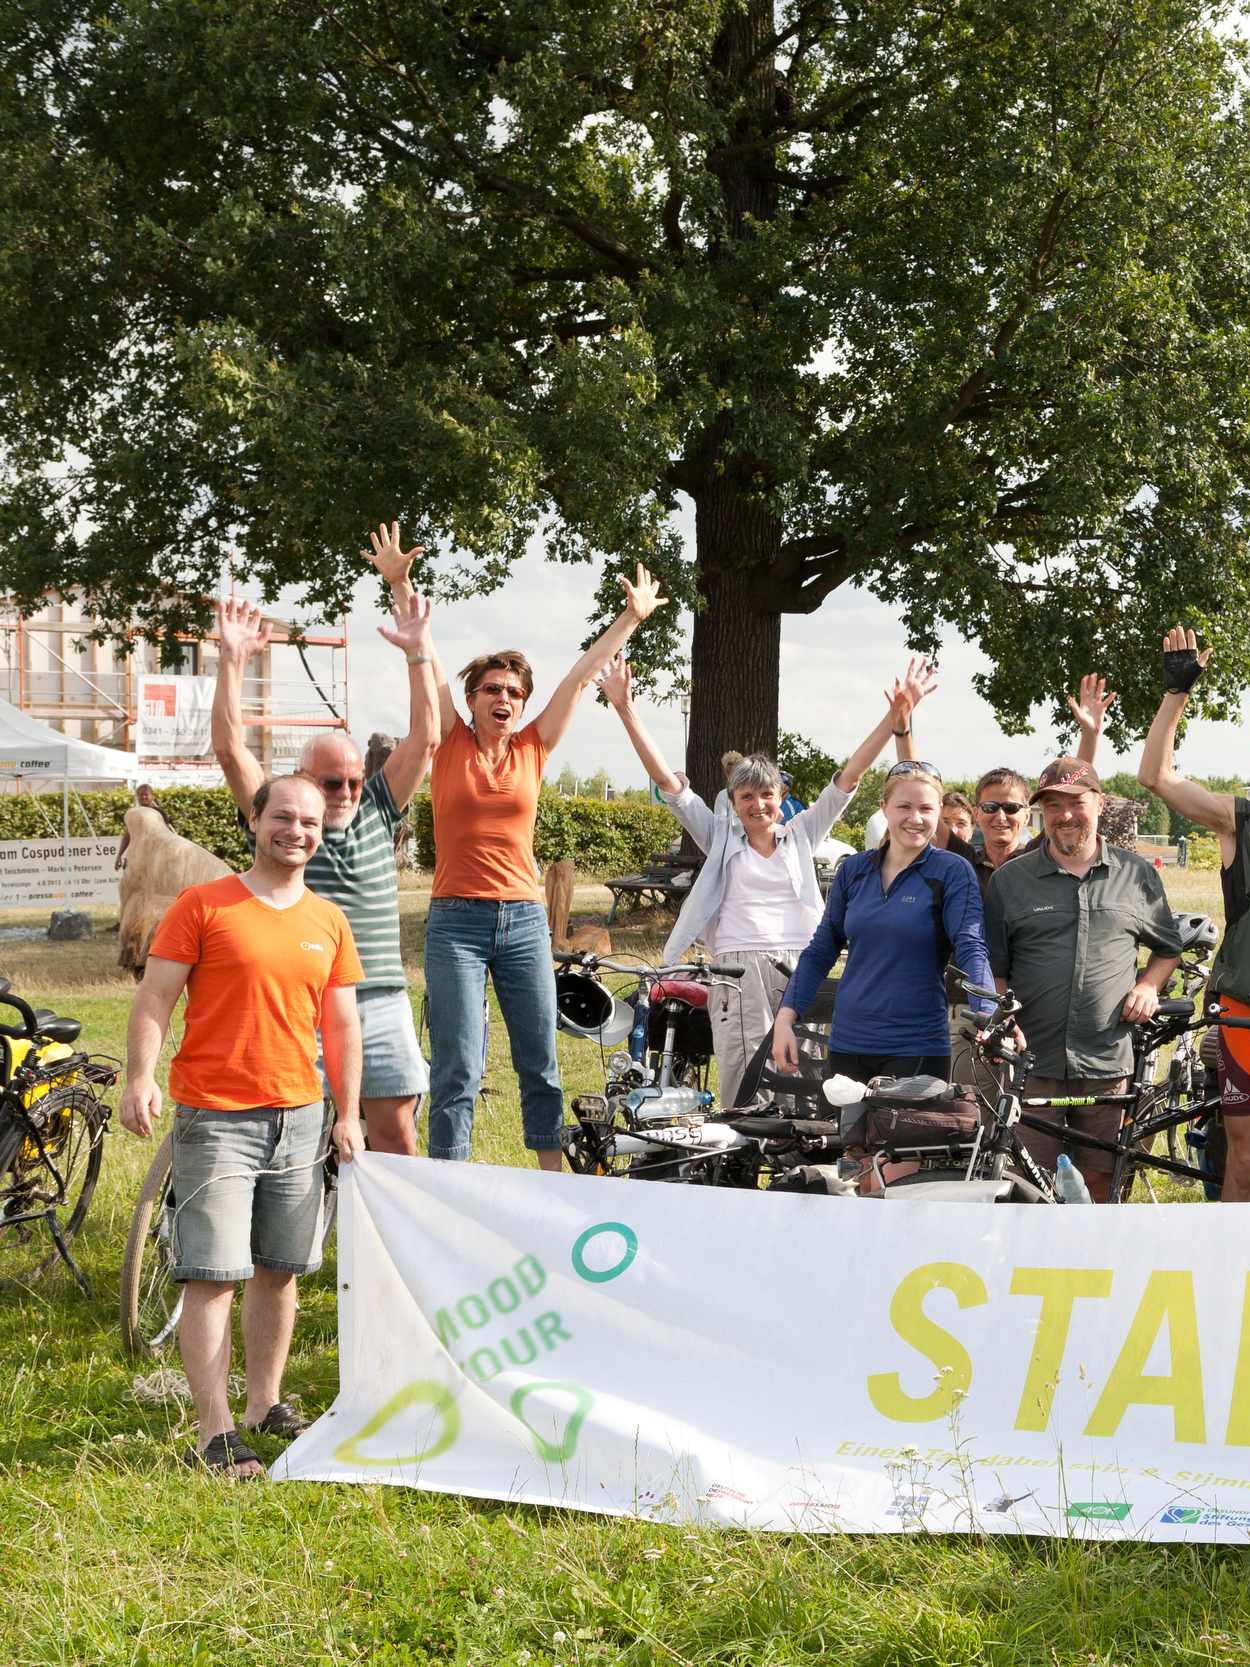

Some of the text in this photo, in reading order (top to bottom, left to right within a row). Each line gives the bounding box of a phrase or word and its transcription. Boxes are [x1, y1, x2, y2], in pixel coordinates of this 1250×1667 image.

[142, 727, 162, 735] 0341
[20, 760, 50, 768] coffee
[0, 844, 116, 860] am Cospudener See
[4, 867, 39, 875] Teichmann
[47, 865, 72, 873] Marks
[74, 864, 102, 872] Petersen
[71, 889, 94, 898] coffee
[431, 1254, 546, 1351] MOOD
[459, 1311, 572, 1381] OUR
[924, 1448, 972, 1468] Tag
[979, 1453, 1060, 1468] dabei
[1067, 1462, 1129, 1475] sein
[1077, 1506, 1120, 1516] AOK
